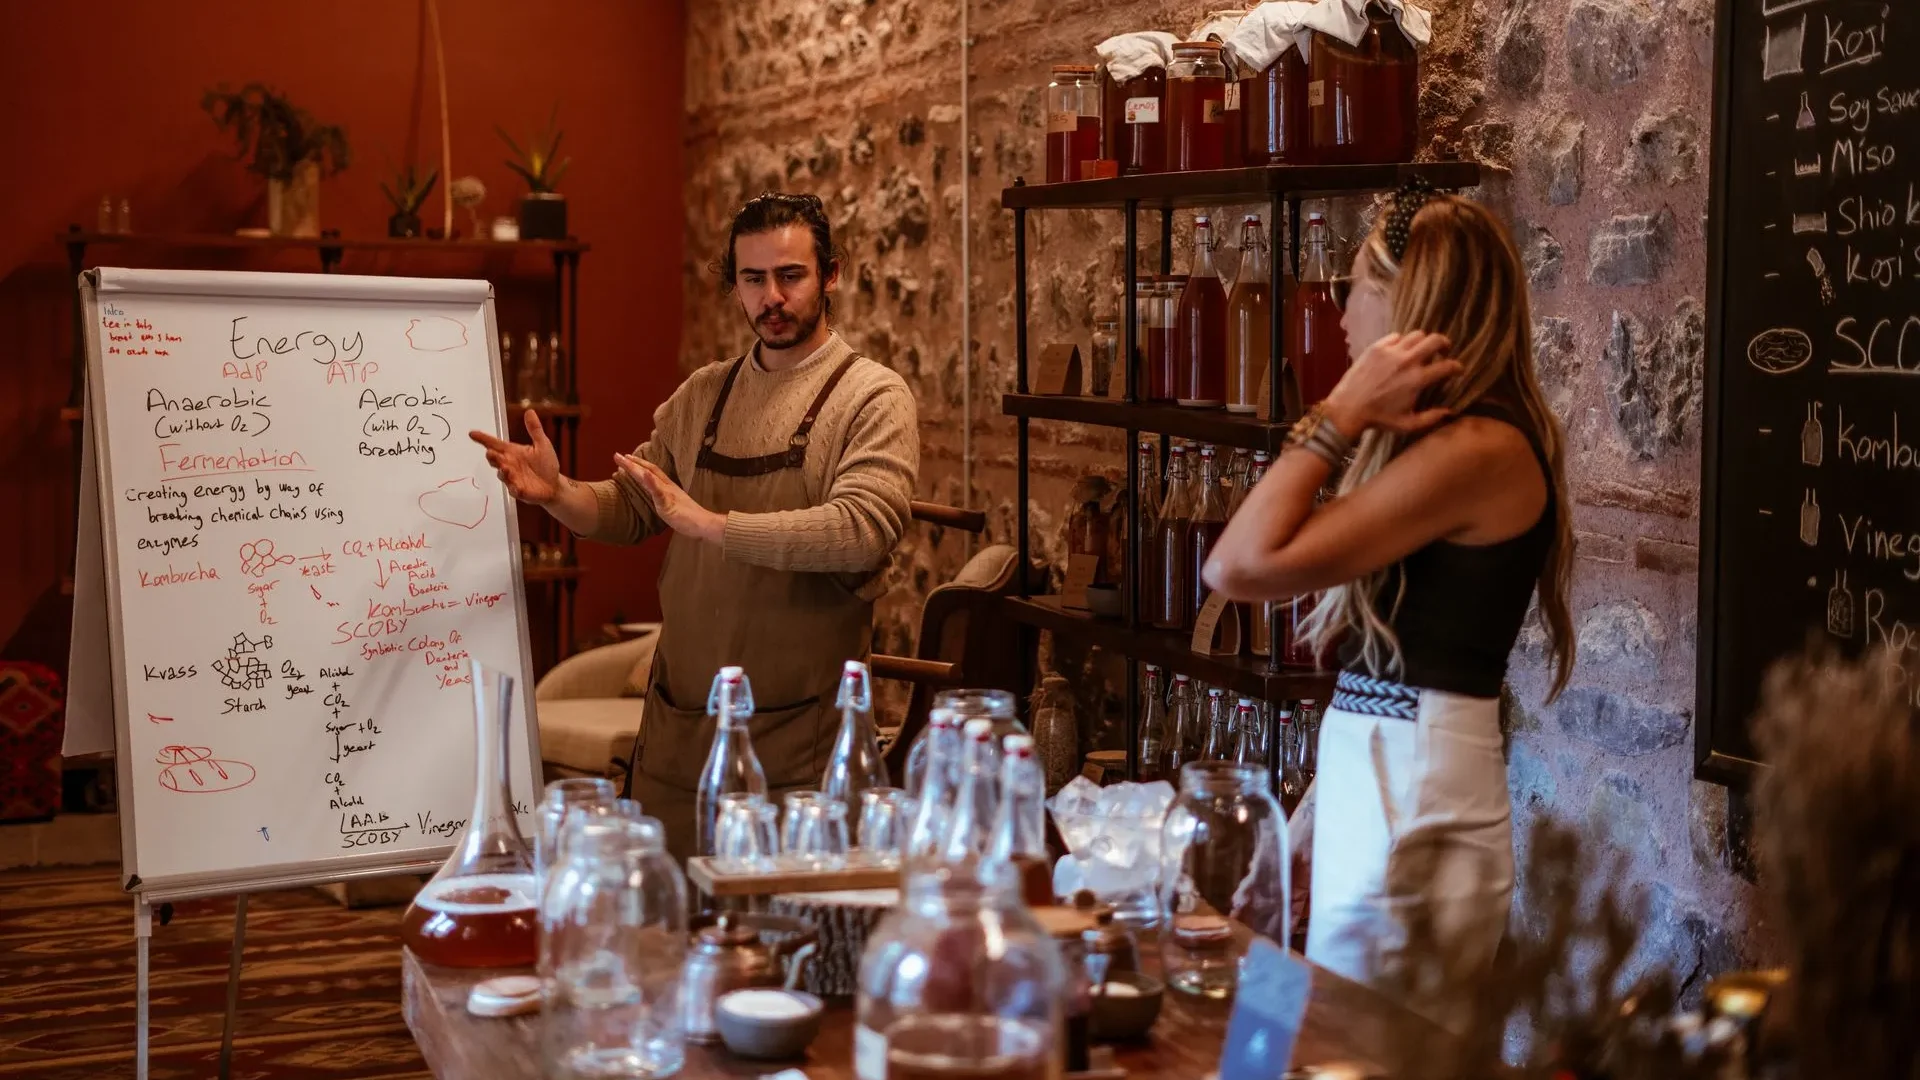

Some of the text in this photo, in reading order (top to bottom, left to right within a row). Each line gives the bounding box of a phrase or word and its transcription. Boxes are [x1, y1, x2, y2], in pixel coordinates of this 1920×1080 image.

[1829, 92, 1871, 132] Soy
[1831, 136, 1896, 175] Miso
[1836, 195, 1896, 236] Shio
[229, 315, 364, 365] Energy
[327, 361, 379, 384] ATP
[146, 387, 272, 412] Anaerobic
[358, 385, 453, 411] Aerobic
[158, 443, 307, 473] Fermentation
[358, 436, 436, 465] Breathing
[193, 484, 246, 503] energy
[255, 478, 271, 500] by
[278, 482, 301, 499] way
[147, 506, 204, 531] breaking
[210, 508, 265, 523] chemical
[136, 533, 199, 556] enzymes
[377, 532, 433, 552] Alcohol
[137, 561, 221, 588] Kombucha
[407, 567, 437, 583] Acid
[408, 581, 450, 598] Bacteria
[465, 592, 508, 609] Vinegar
[331, 617, 408, 646] SCOBY
[407, 635, 446, 651] Colony
[443, 663, 459, 672] and
[435, 673, 472, 690] Yeas
[221, 697, 267, 715] Starch
[416, 810, 468, 838] Vinegar
[340, 829, 402, 849] SCOBY
